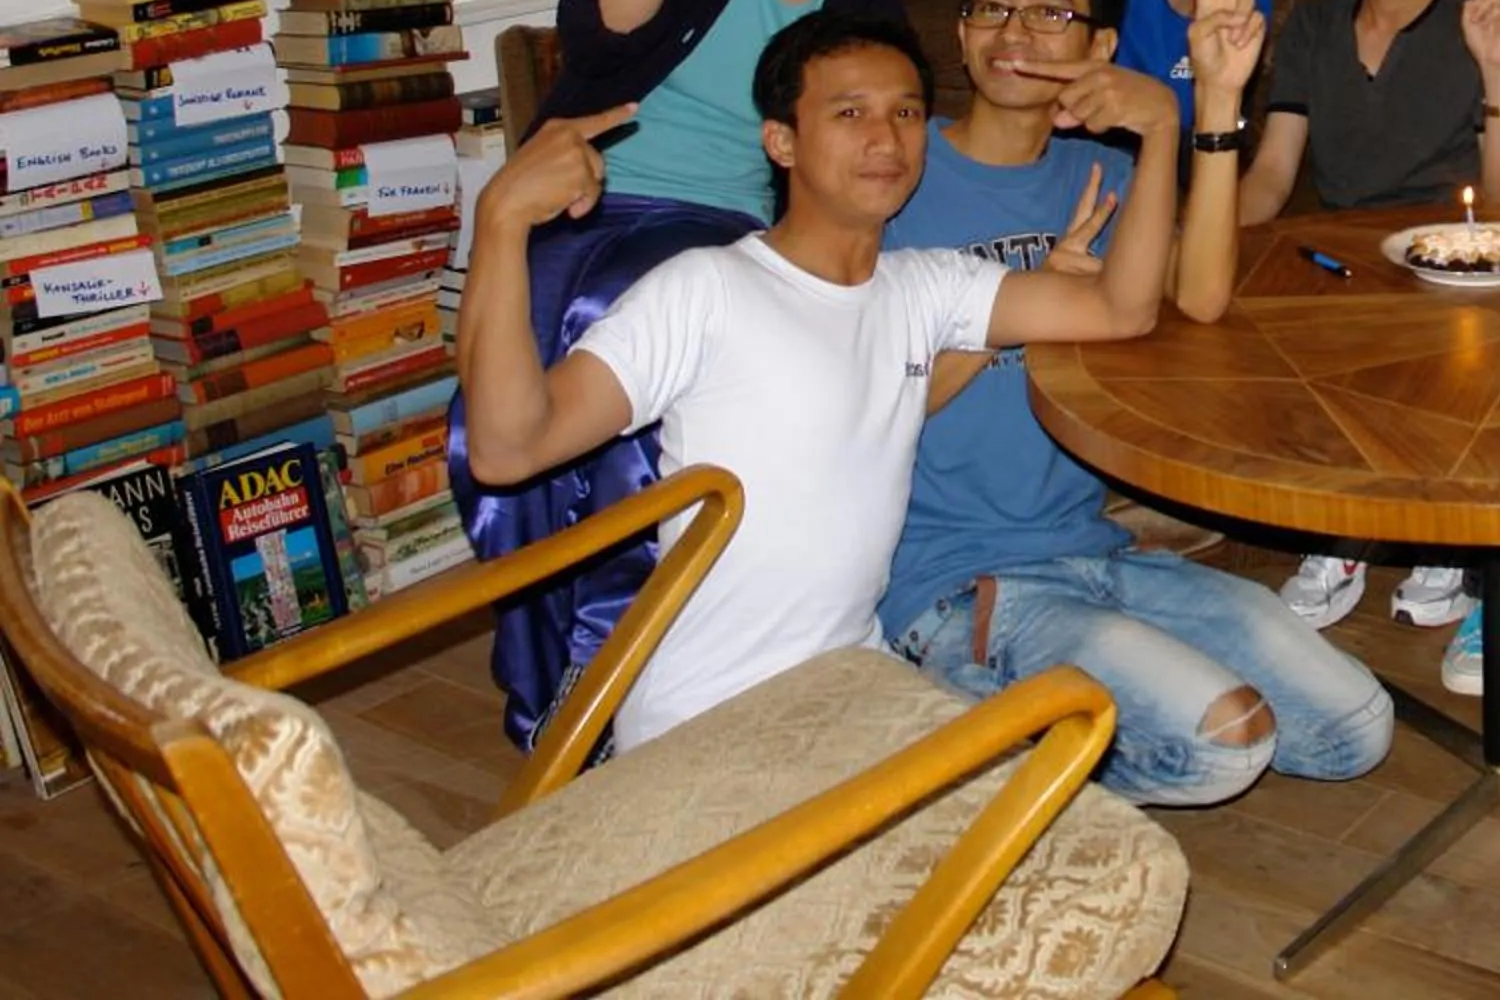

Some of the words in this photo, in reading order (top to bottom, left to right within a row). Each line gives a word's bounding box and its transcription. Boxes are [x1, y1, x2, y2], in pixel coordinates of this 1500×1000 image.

[110, 470, 165, 509] ANN
[219, 459, 303, 510] ADAC
[228, 505, 310, 542] Reiseführer
[232, 493, 299, 522] Autobahn
